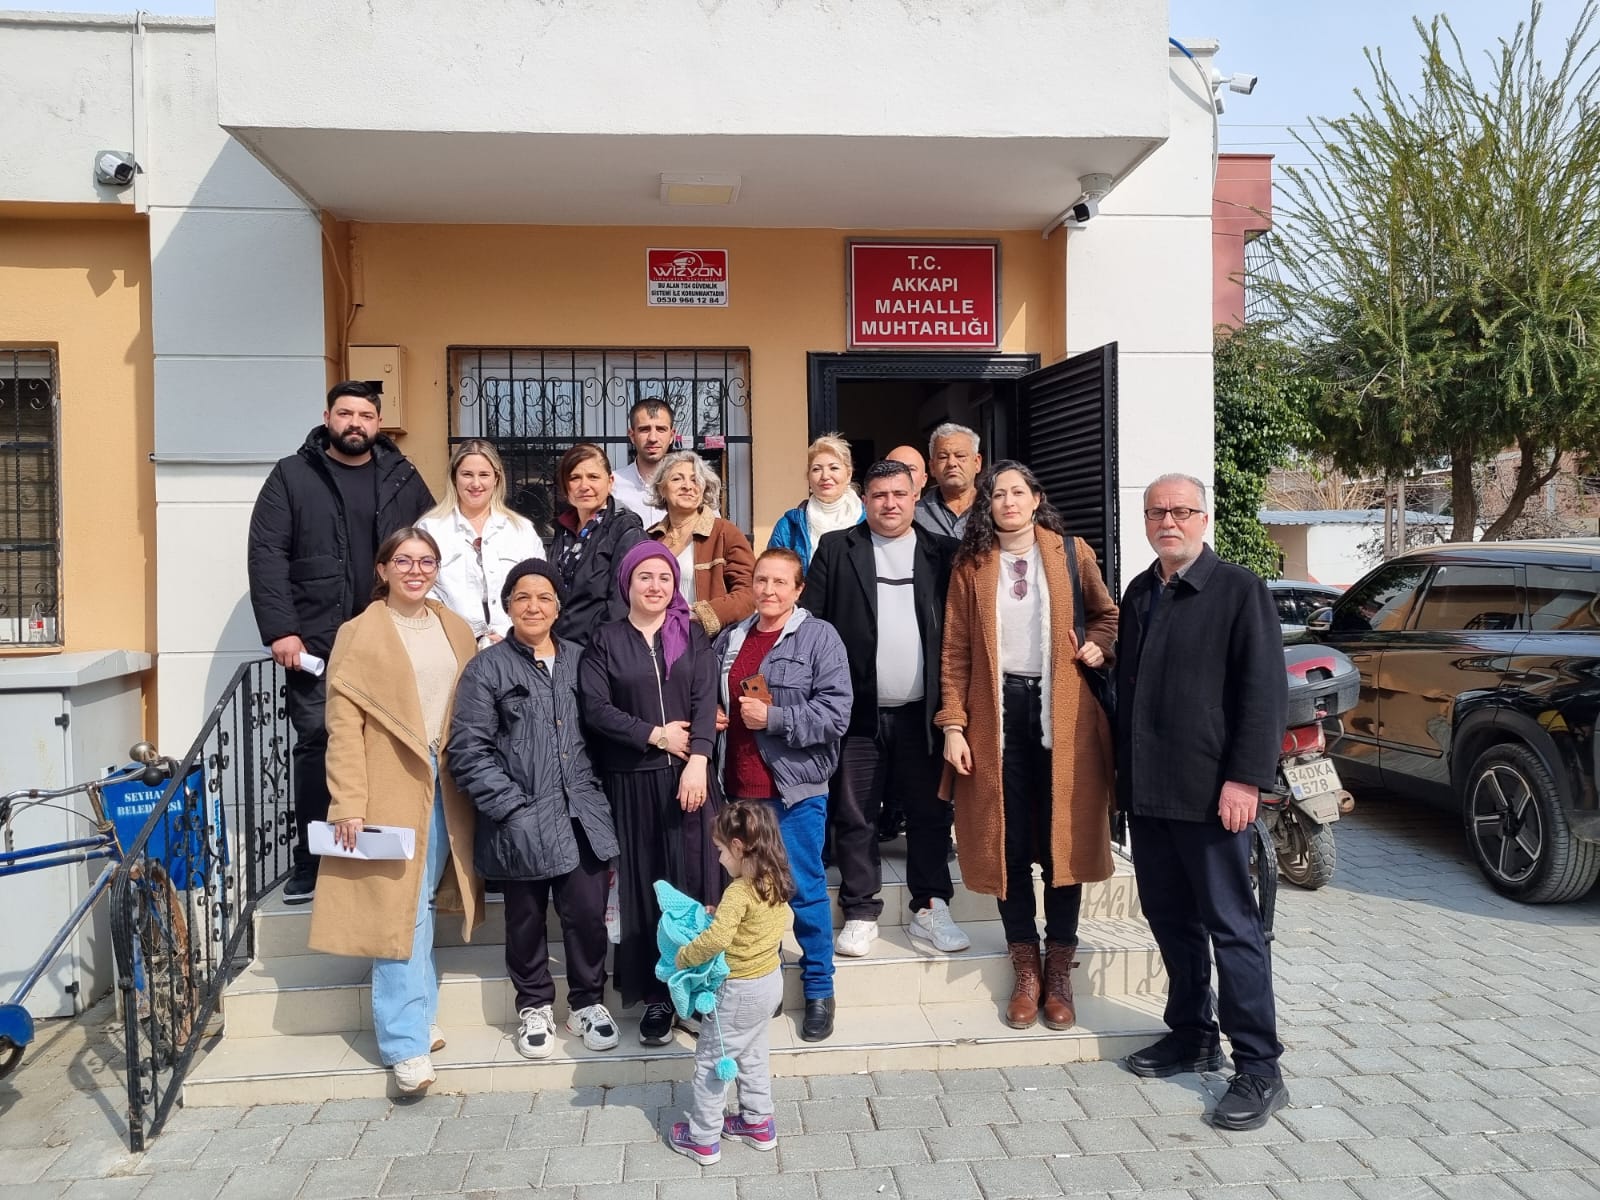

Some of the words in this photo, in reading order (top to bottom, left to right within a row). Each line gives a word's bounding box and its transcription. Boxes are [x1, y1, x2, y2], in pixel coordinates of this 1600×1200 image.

[908, 255, 941, 270] T.C.
[891, 278, 958, 292] AKKAPI
[875, 299, 974, 314] MAHALLE
[861, 317, 988, 336] MUHTARLIĞI
[1302, 779, 1328, 794] 578
